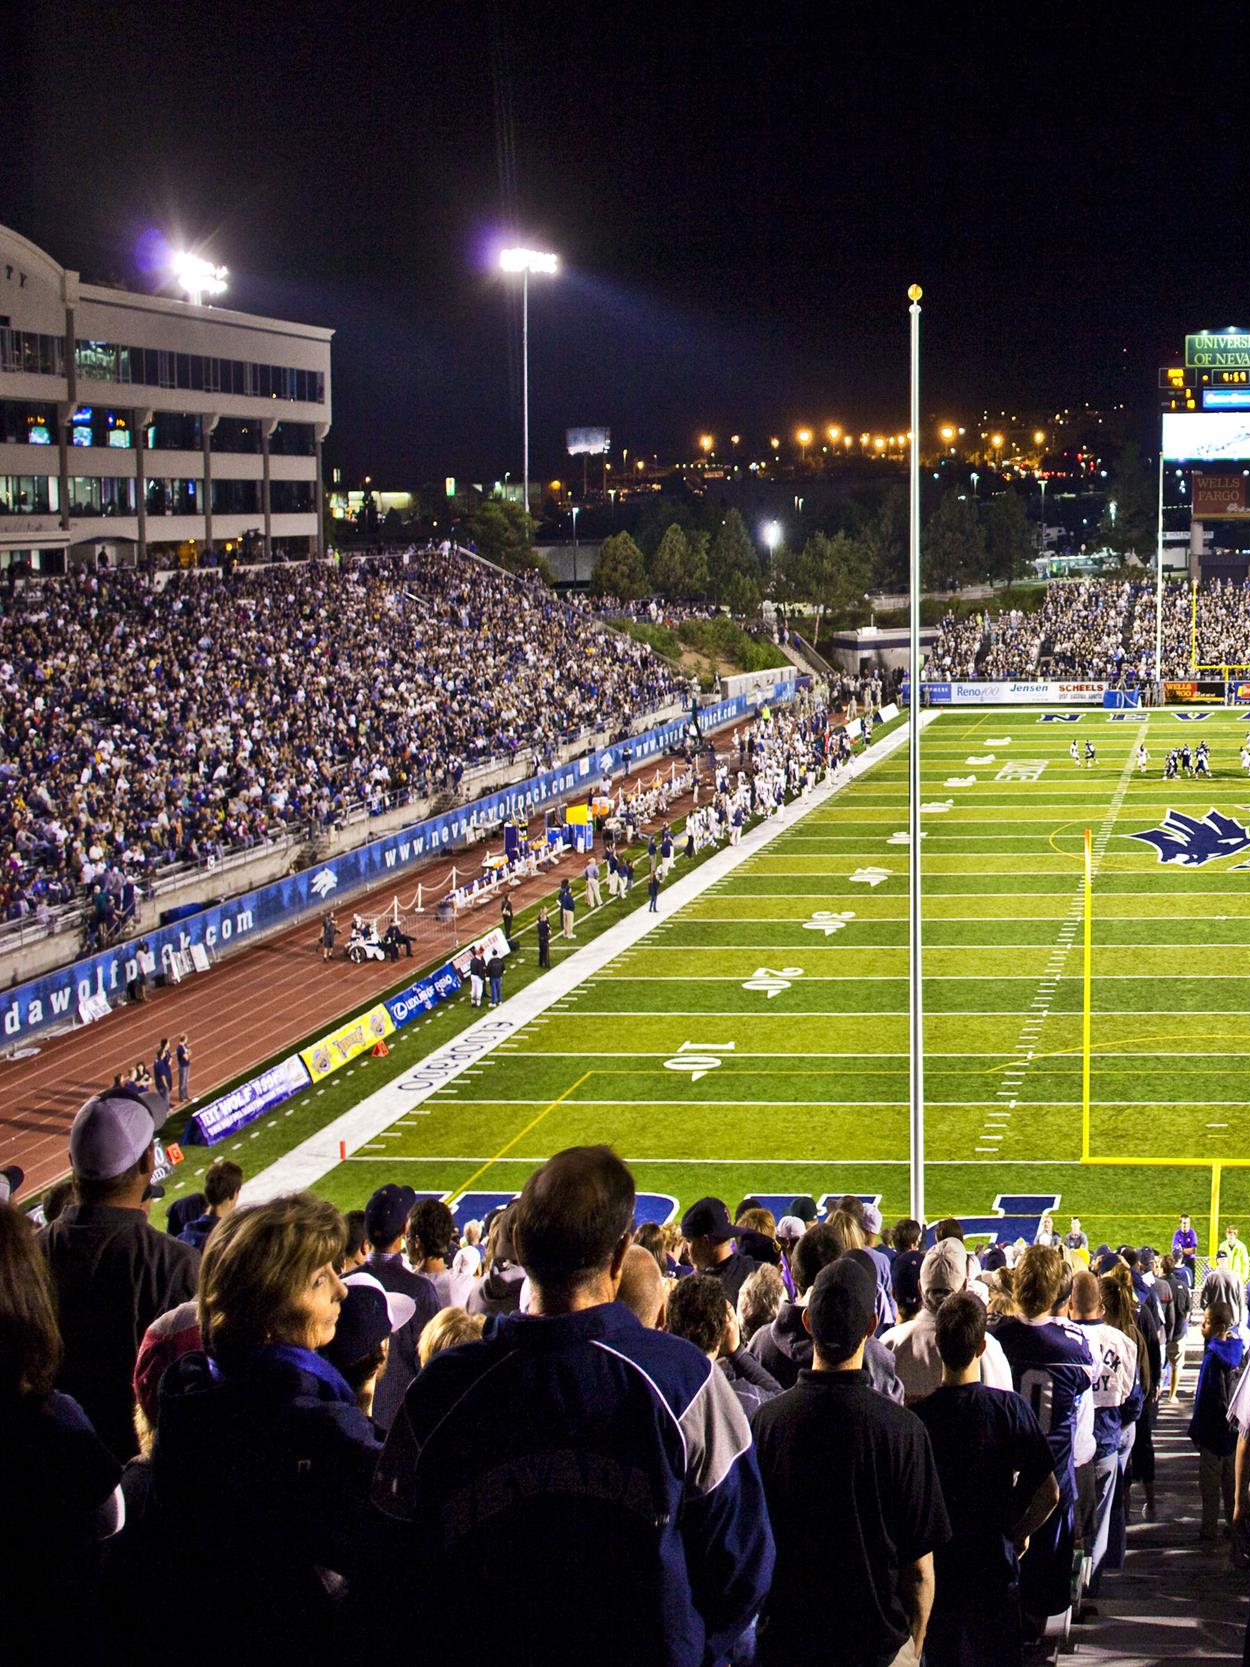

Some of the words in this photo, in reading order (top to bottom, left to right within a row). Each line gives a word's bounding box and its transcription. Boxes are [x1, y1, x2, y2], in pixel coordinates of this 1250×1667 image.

[1194, 353, 1212, 365] OF
[1197, 478, 1240, 488] WELLS
[1198, 490, 1240, 501] FARGO
[956, 685, 981, 697] Reno
[1010, 683, 1048, 692] Jensen
[1058, 683, 1104, 692] SCHEELS
[802, 911, 857, 931] 30
[741, 967, 804, 991] 20
[663, 1040, 736, 1071] 10
